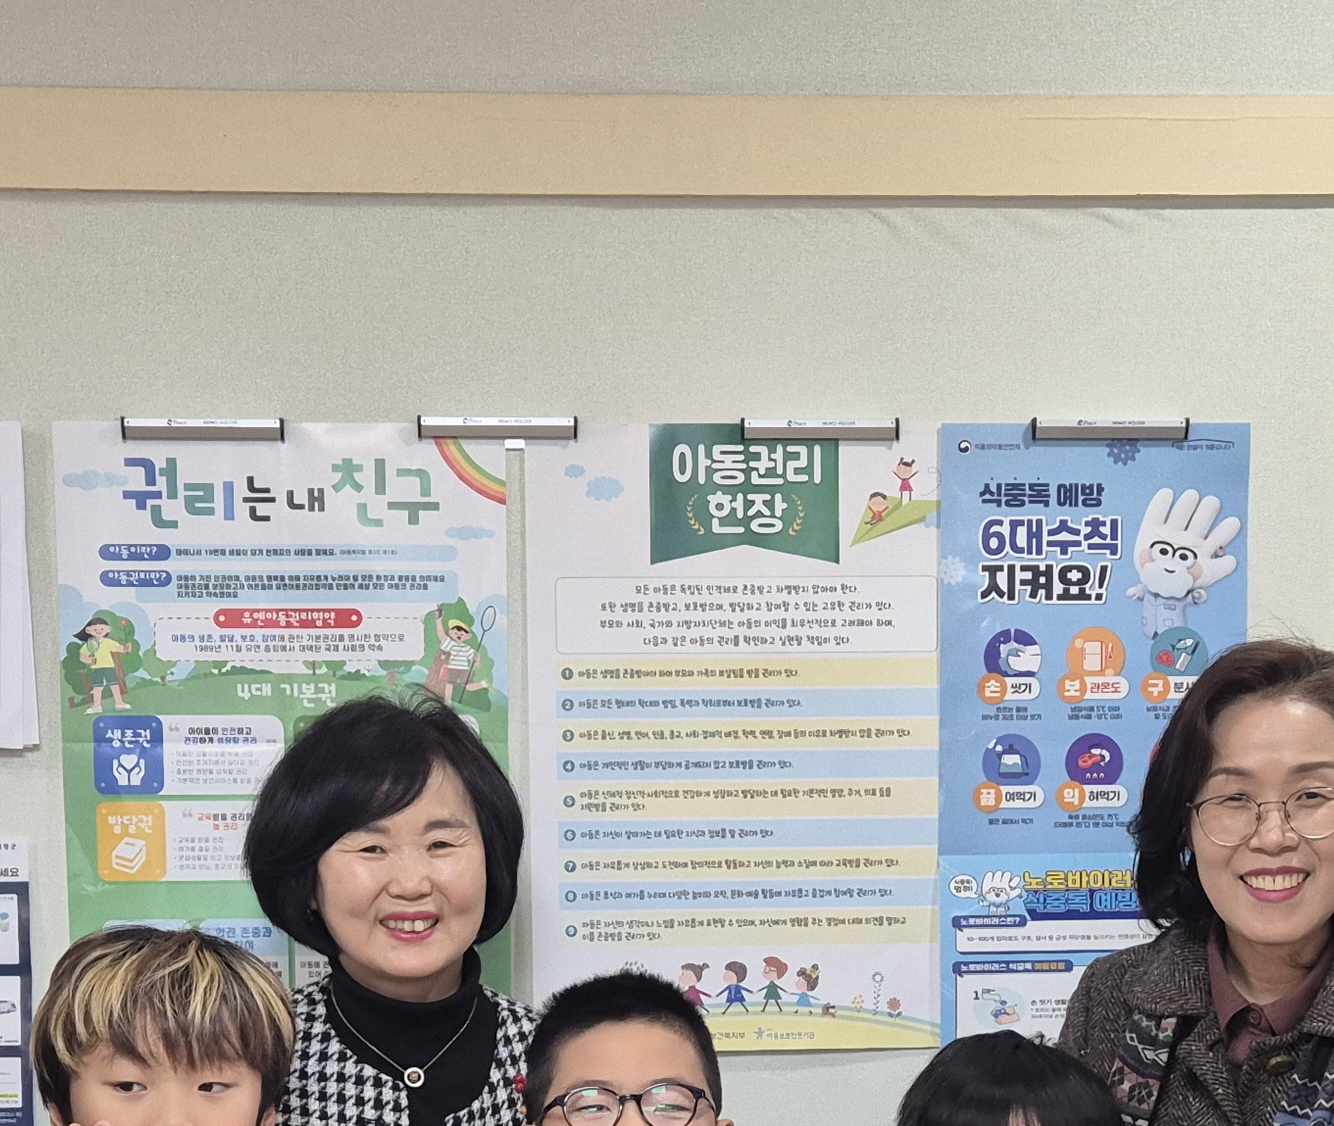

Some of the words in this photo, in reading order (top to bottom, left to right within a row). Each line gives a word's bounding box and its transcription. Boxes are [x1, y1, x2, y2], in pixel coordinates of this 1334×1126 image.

[672, 443, 821, 485] 아동권리
[122, 455, 277, 529] 권리는
[285, 484, 326, 513] 내
[331, 456, 439, 528] 친구
[979, 483, 1051, 508] 식중독
[1057, 483, 1104, 508] 예방
[707, 491, 788, 535] 헌장
[981, 518, 1119, 556] 6대수칙
[109, 546, 157, 559] 아동이란?
[108, 571, 166, 585] 아동권리란?
[980, 565, 1108, 602] 지켜요!
[241, 611, 336, 627] 유엔아동권리협약
[172, 634, 195, 643] 아동의
[240, 634, 258, 643] 보호,
[193, 644, 221, 653] 1989년
[225, 644, 242, 653] 11월
[324, 644, 339, 653] 국제
[237, 683, 271, 700] 4대
[279, 684, 336, 707] 기본권
[105, 729, 151, 748] 생존권
[187, 726, 219, 735] 아이들이
[221, 726, 251, 735] 안전하고
[108, 814, 153, 834] 발달권
[1024, 871, 1136, 889] 노로바이러
[1024, 892, 1088, 911] 식중독
